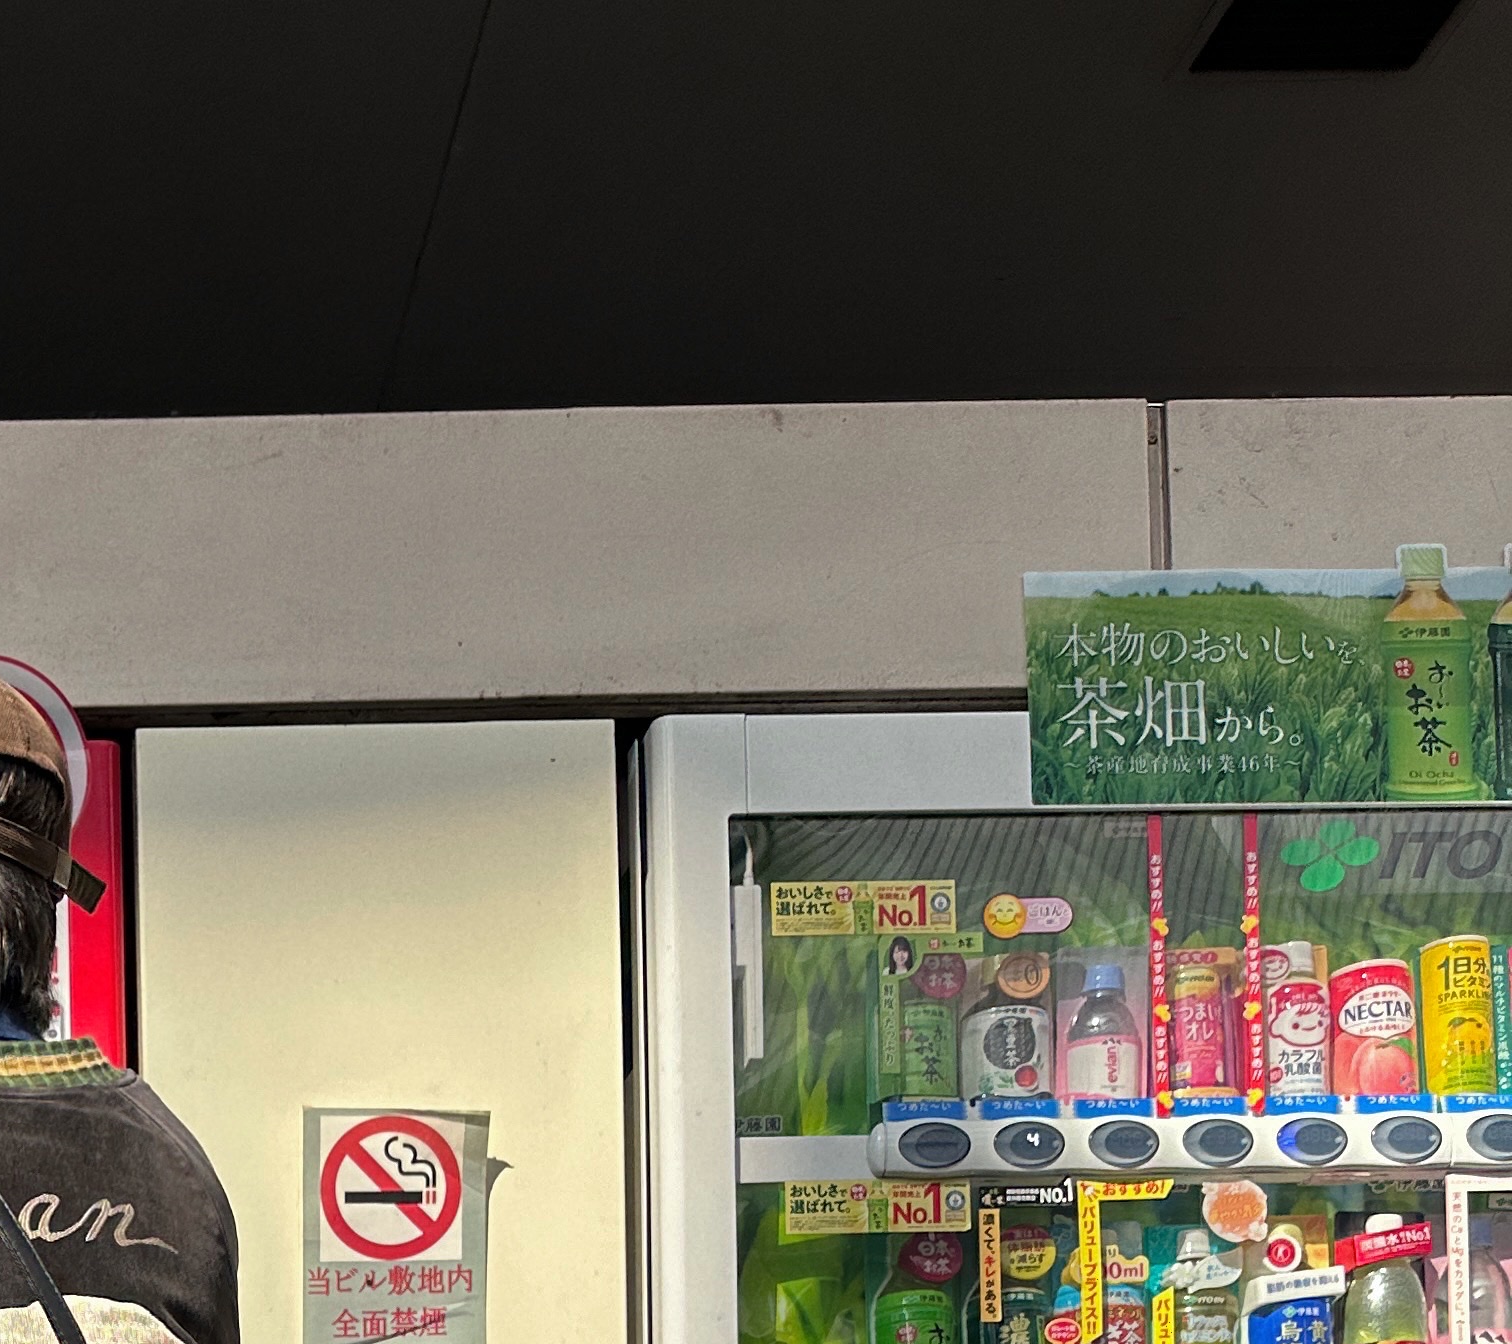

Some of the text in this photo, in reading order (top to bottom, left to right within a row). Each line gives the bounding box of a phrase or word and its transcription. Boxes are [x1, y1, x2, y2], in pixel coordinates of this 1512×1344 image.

[1056, 621, 1365, 667] 本物のおいしいを、
[1056, 675, 1304, 750] 茶畑から。
[1344, 1001, 1413, 1025] NECTAR
[1040, 1178, 1074, 1204] NO.1
[307, 1263, 473, 1296] 当ビル敷地内
[332, 1306, 448, 1339] 全面禁煙
